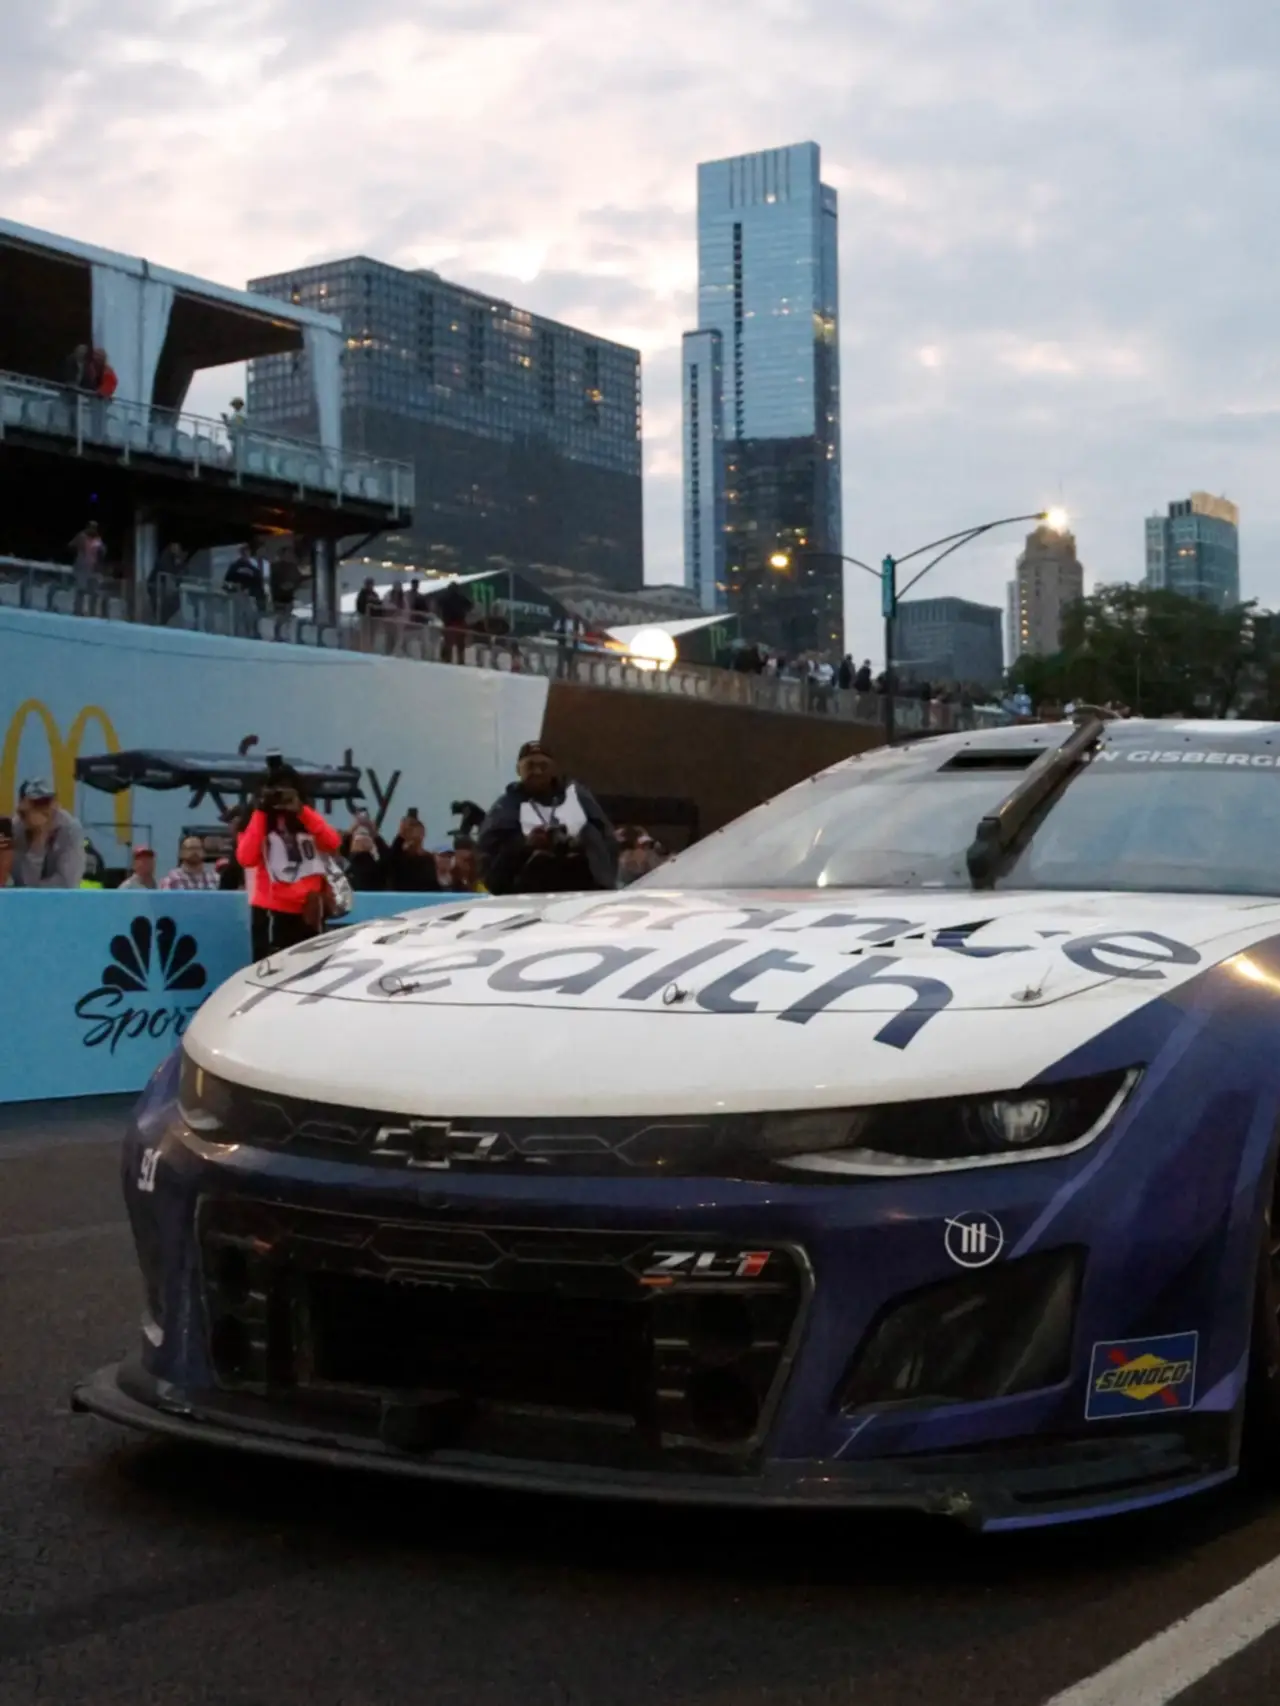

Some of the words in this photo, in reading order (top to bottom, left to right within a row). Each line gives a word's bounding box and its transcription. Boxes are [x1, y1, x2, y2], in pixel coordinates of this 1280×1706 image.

[229, 936, 955, 1050] health
[642, 1251, 772, 1277] ZL1
[1096, 1361, 1192, 1392] SUNOCO
